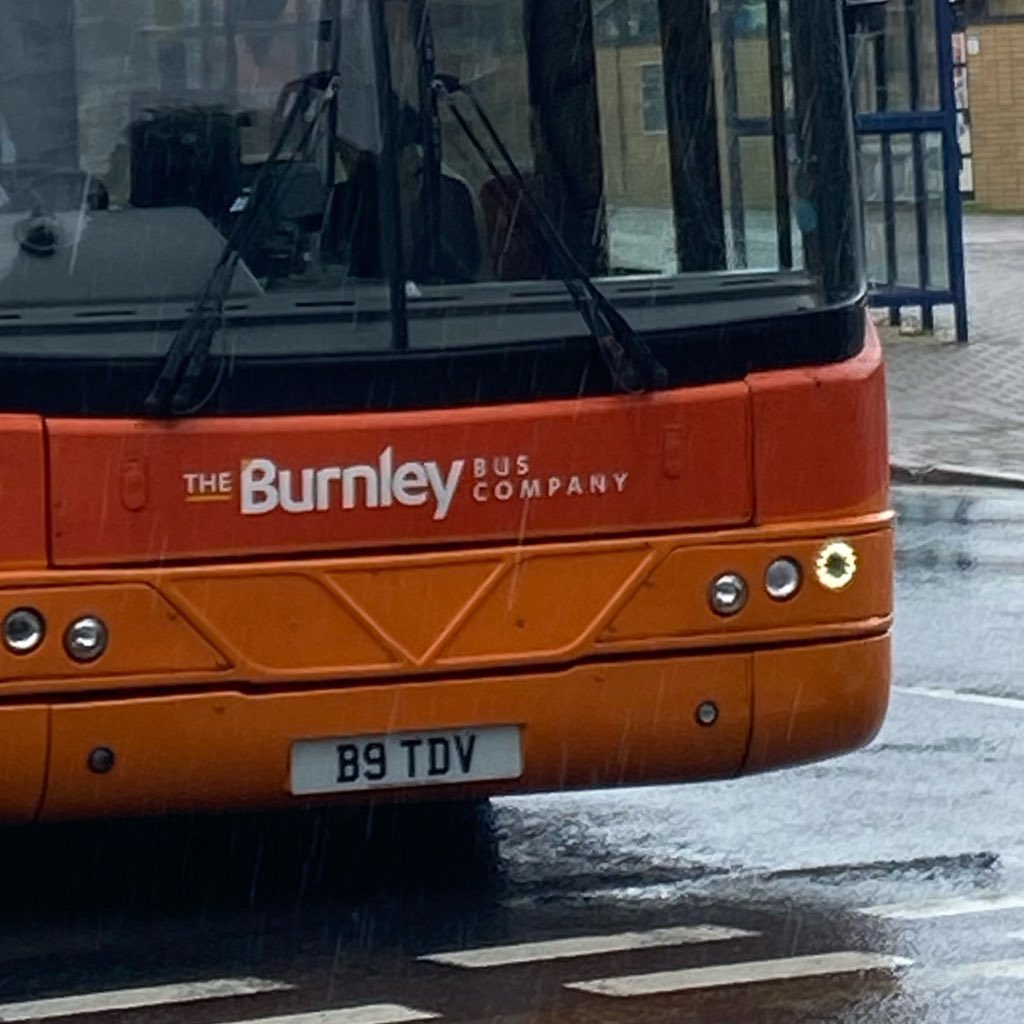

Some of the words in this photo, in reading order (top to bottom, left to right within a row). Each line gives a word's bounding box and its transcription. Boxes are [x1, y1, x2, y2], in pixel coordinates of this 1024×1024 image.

[183, 472, 232, 494] THE
[240, 446, 465, 521] Burnley
[474, 454, 530, 477] BUS
[473, 472, 629, 502] COMPANY
[337, 741, 387, 784] B9
[400, 734, 475, 779] TDV
